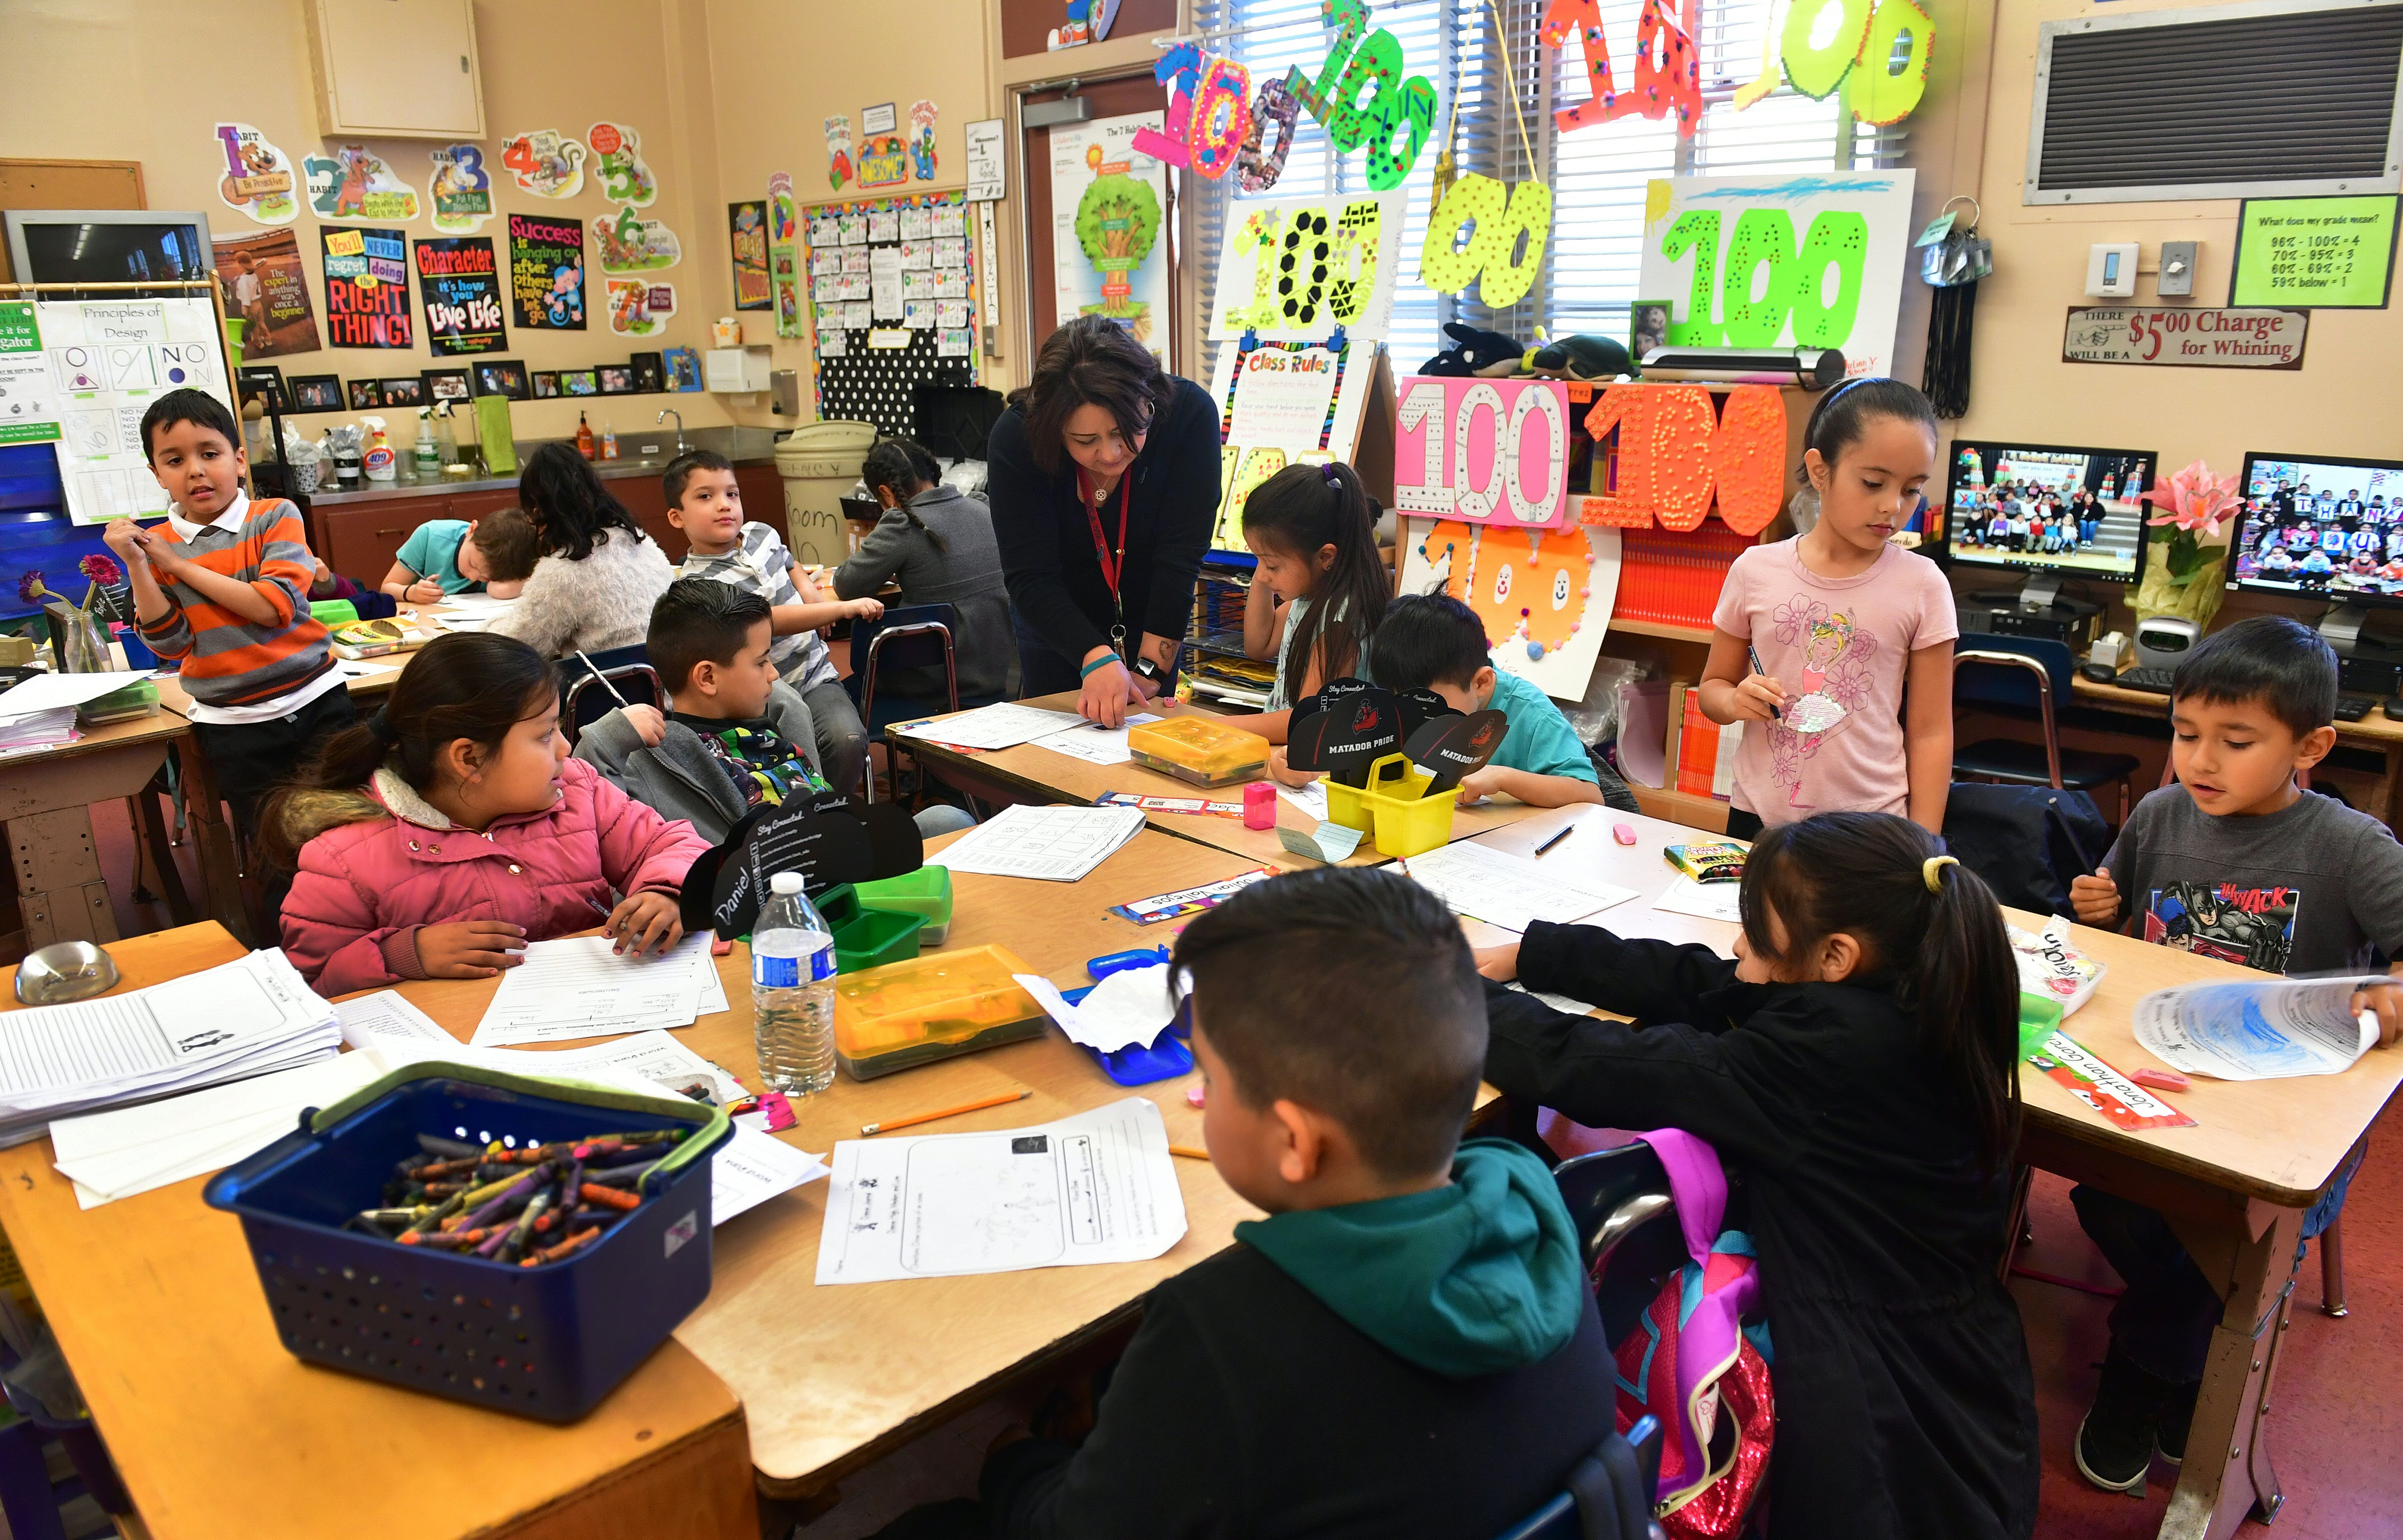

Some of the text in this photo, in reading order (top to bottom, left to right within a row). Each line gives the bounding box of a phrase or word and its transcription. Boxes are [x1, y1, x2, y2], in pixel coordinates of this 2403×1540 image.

[1107, 128, 1117, 137] The
[1119, 127, 1123, 135] 7
[2259, 214, 2379, 226] What does my grade mean?
[510, 216, 581, 247] Success
[330, 234, 401, 256] You'll NEVER
[517, 237, 528, 249] is
[2271, 236, 2296, 247] 96%
[2308, 235, 2341, 246] 100%
[2352, 235, 2360, 246] 4
[512, 244, 579, 265] hanging on
[2272, 249, 2298, 261] 70%
[2309, 249, 2335, 260] 95%
[2347, 248, 2354, 259] 3
[327, 258, 403, 281] regret doing
[513, 257, 548, 274] after
[1224, 199, 1381, 330] 100
[2271, 263, 2296, 274] 60%
[2308, 262, 2333, 274] 69%
[2344, 262, 2352, 273] 2
[270, 269, 285, 278] The
[360, 275, 373, 287] the
[1662, 208, 1868, 349] 100
[2271, 276, 2297, 287] 59%
[2299, 276, 2329, 287] below
[2342, 276, 2346, 287] 1
[264, 278, 289, 287] expert
[269, 284, 300, 296] anything
[439, 279, 485, 292] It's how
[513, 274, 554, 290] others
[281, 292, 295, 301] was
[329, 280, 406, 315] RIGHT
[452, 290, 474, 305] you
[514, 284, 543, 300] have
[270, 306, 305, 320] beginner
[427, 293, 501, 333] Live Life
[524, 299, 540, 311] let
[84, 304, 161, 323] Principles of
[2086, 312, 2125, 320] THERE
[329, 313, 411, 345] THING!
[2197, 311, 2284, 340] Charge
[104, 327, 148, 341] Design
[2070, 351, 2130, 359] WILL BE A
[2181, 339, 2294, 361] for Whining
[1250, 352, 1331, 374] Class Rules
[368, 452, 387, 463] 409
[1396, 383, 1564, 522] 100
[1578, 384, 1787, 536] 100
[1328, 685, 1341, 694] Stay
[1329, 734, 1395, 754] MATADOR PRIDE
[1440, 748, 1473, 764] MATADOR
[757, 825, 772, 836] Stay
[715, 866, 750, 926] Daniel
[1152, 890, 1214, 905] Vallejos
[2220, 882, 2289, 913] THWACK
[578, 988, 621, 996] Sentences
[612, 1047, 666, 1063] Word Bank
[2084, 1064, 2154, 1109] Jonathan
[724, 1159, 771, 1185] Word Bank
